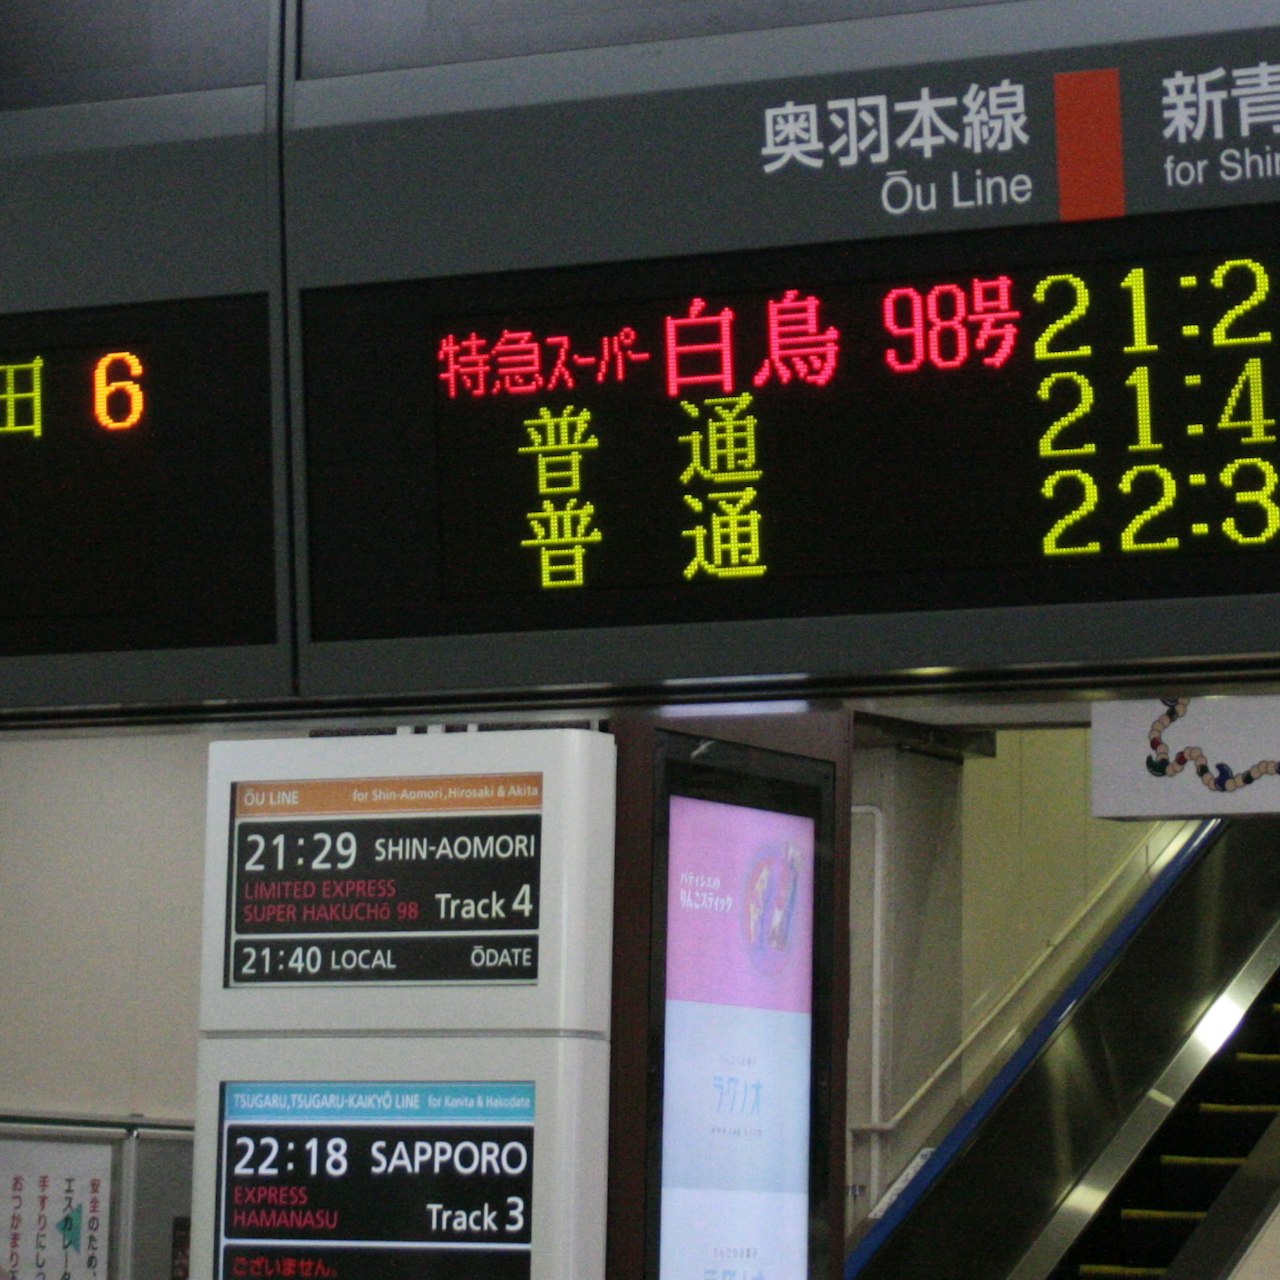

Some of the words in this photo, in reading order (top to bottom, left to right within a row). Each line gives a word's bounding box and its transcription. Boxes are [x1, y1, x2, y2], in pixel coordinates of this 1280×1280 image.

[761, 79, 1031, 176] 奥羽本線
[881, 168, 943, 216] Ōu
[951, 165, 1033, 209] Line
[1163, 155, 1203, 188] for
[94, 351, 144, 430] 6
[518, 392, 763, 495] 普通
[520, 487, 767, 589] 普通
[270, 790, 299, 805] LINE
[352, 789, 368, 802] for
[497, 786, 505, 798] &
[508, 784, 538, 798] Akita
[244, 830, 357, 872] 21:29
[375, 834, 535, 861] SHIN-AOMORI
[244, 880, 316, 900] LIMITED
[322, 878, 396, 898] EXPRESS
[435, 891, 505, 919] Track
[511, 883, 533, 917] 4
[243, 904, 295, 923] SUPER
[397, 901, 418, 919] 98
[241, 946, 320, 974] 21:40
[331, 950, 396, 970] LOCAL
[470, 946, 532, 968] ŌDATE
[395, 1094, 420, 1109] LINE
[428, 1095, 442, 1108] for
[234, 1136, 348, 1177] 22:18
[370, 1140, 527, 1174] SAPPORO
[234, 1186, 308, 1206] EXPRESS
[426, 1202, 498, 1231] Track
[505, 1196, 524, 1231] 3
[234, 1210, 338, 1229] HAMANASU
